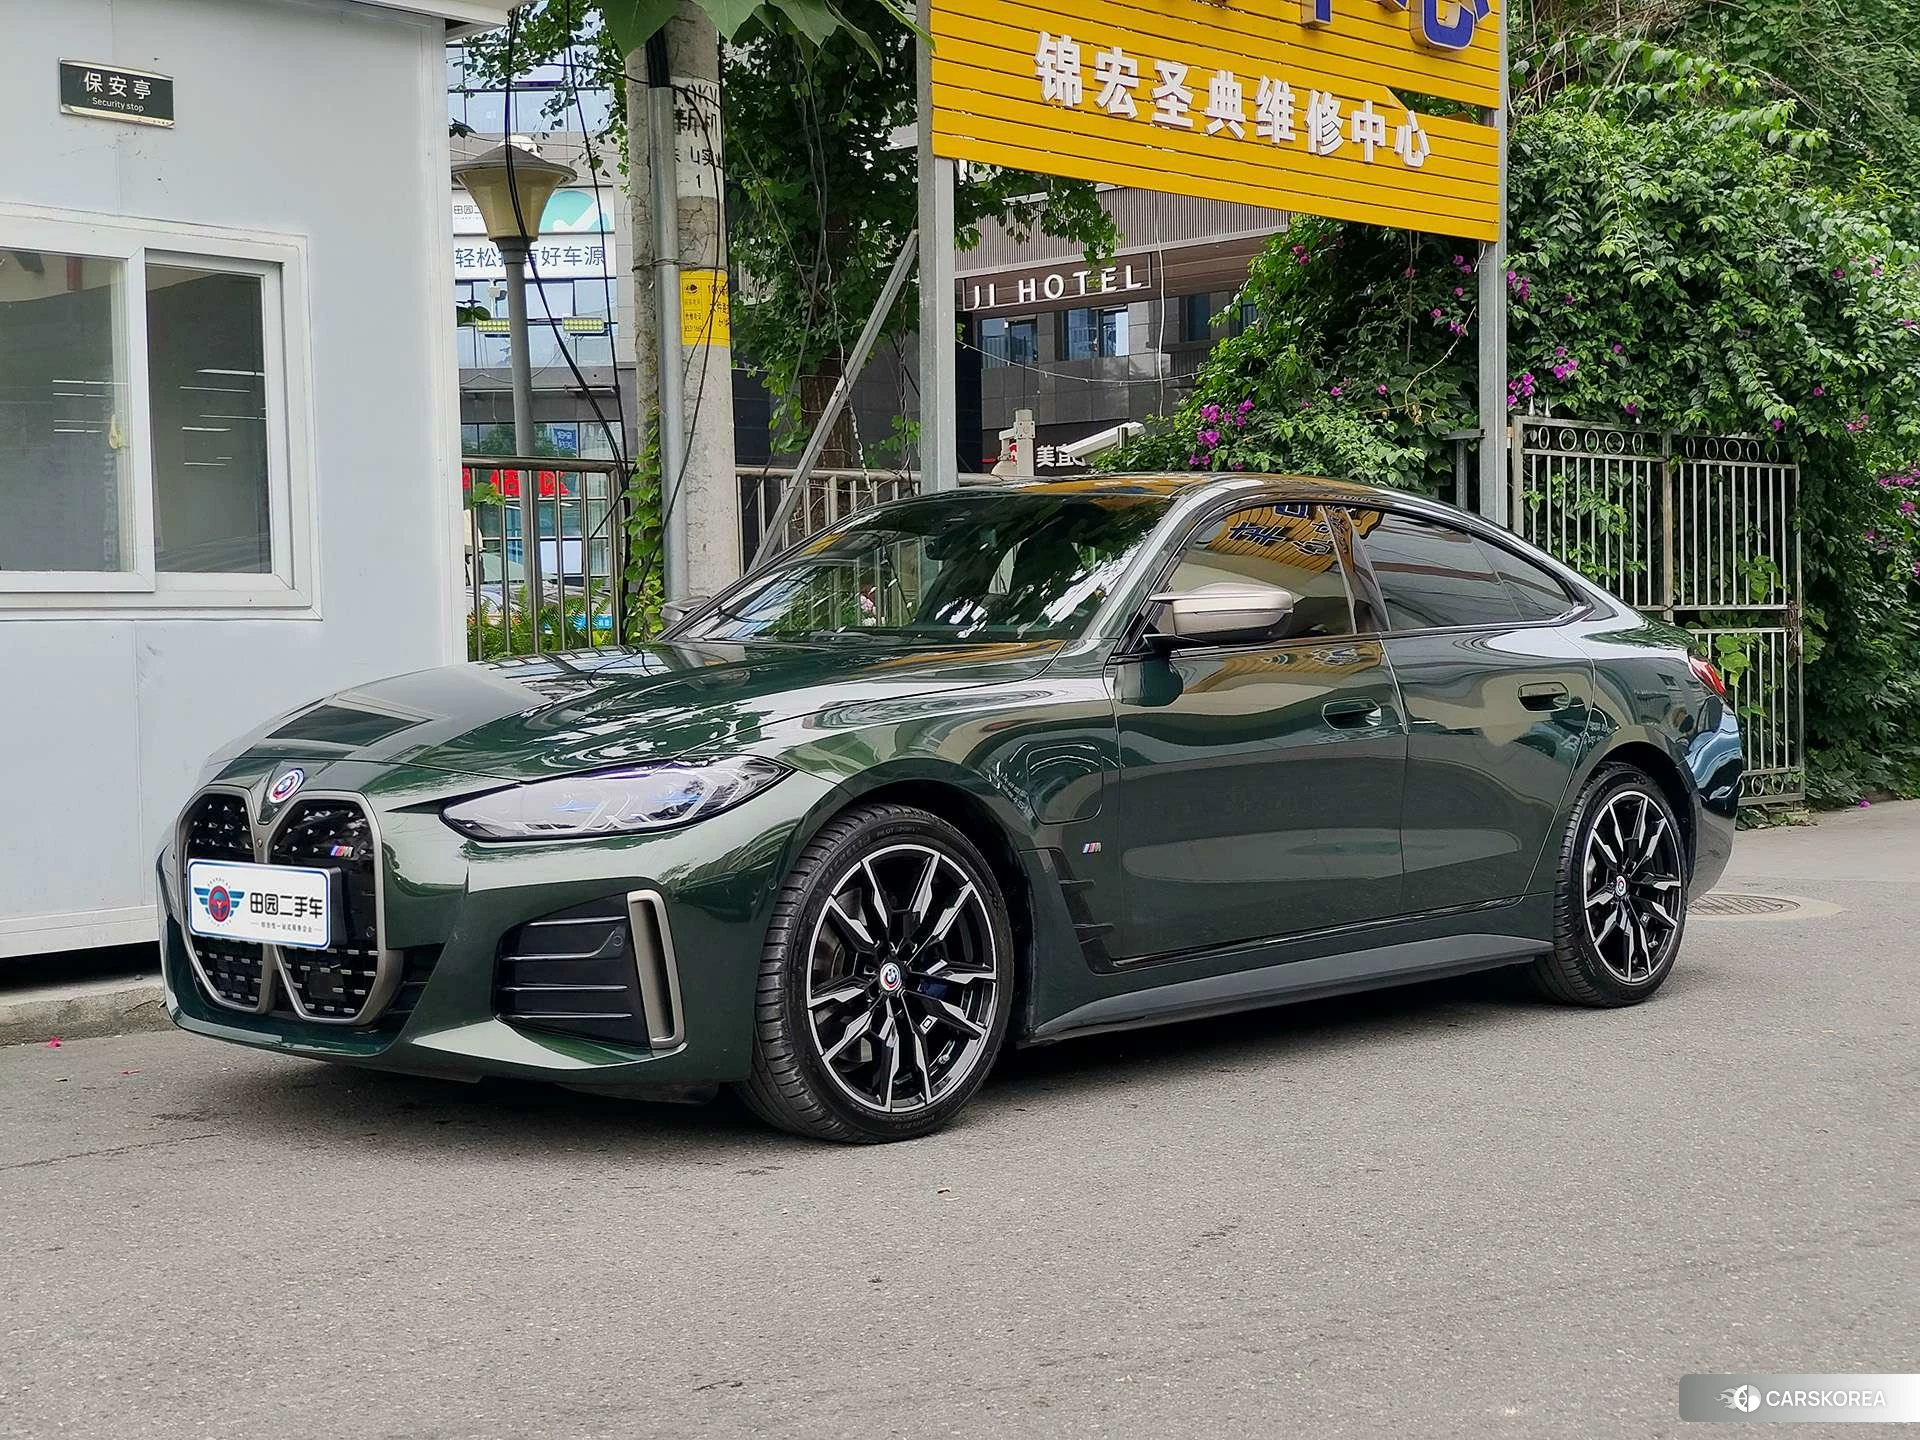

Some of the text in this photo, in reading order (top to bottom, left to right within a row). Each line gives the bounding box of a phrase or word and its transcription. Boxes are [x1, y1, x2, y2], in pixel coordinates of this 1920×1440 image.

[83, 71, 151, 100] 保安亭
[1033, 31, 1431, 168] 锦宏圣典维修中心
[92, 97, 144, 112] Security stop
[455, 245, 605, 268] 轻松有好车源
[974, 265, 1142, 309] JI HOTEL
[250, 892, 323, 919] 田园二手车
